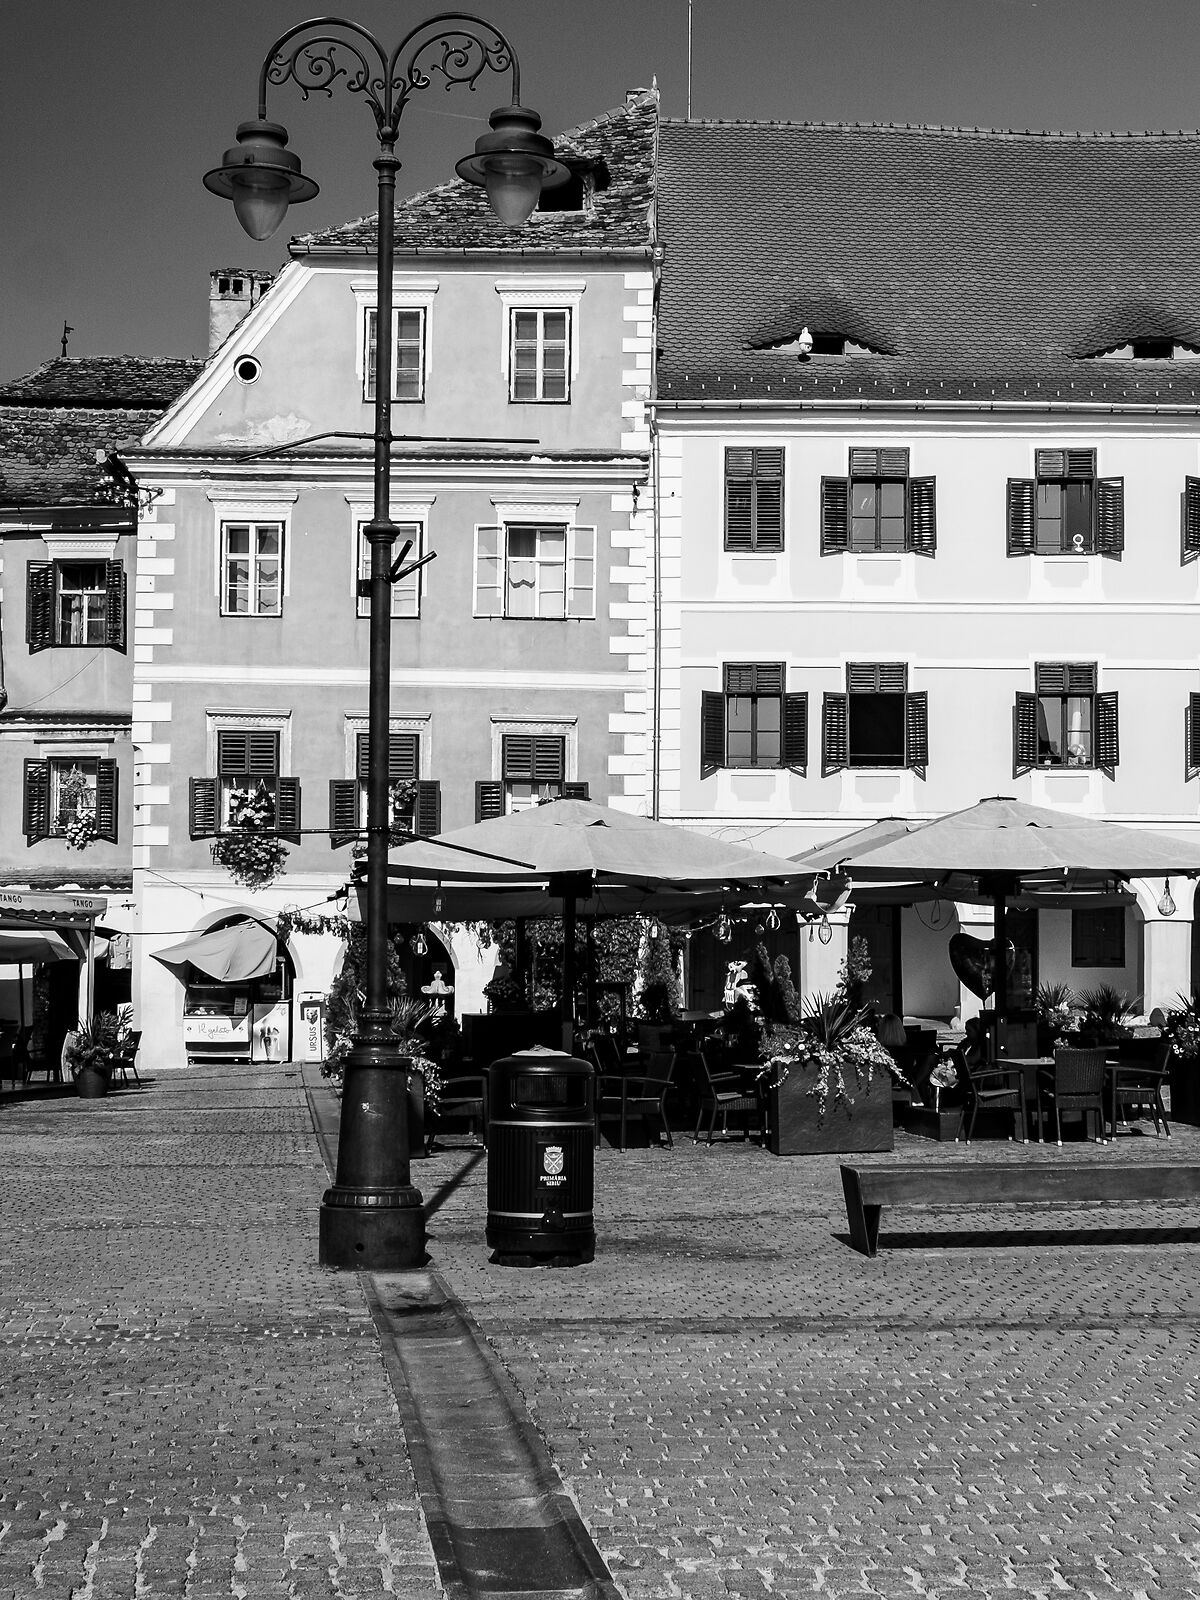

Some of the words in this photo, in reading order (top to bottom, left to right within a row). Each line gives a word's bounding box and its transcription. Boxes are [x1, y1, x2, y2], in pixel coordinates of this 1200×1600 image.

[0, 894, 23, 903] TANGO
[72, 899, 93, 908] TANGO
[308, 1026, 318, 1052] URSUS
